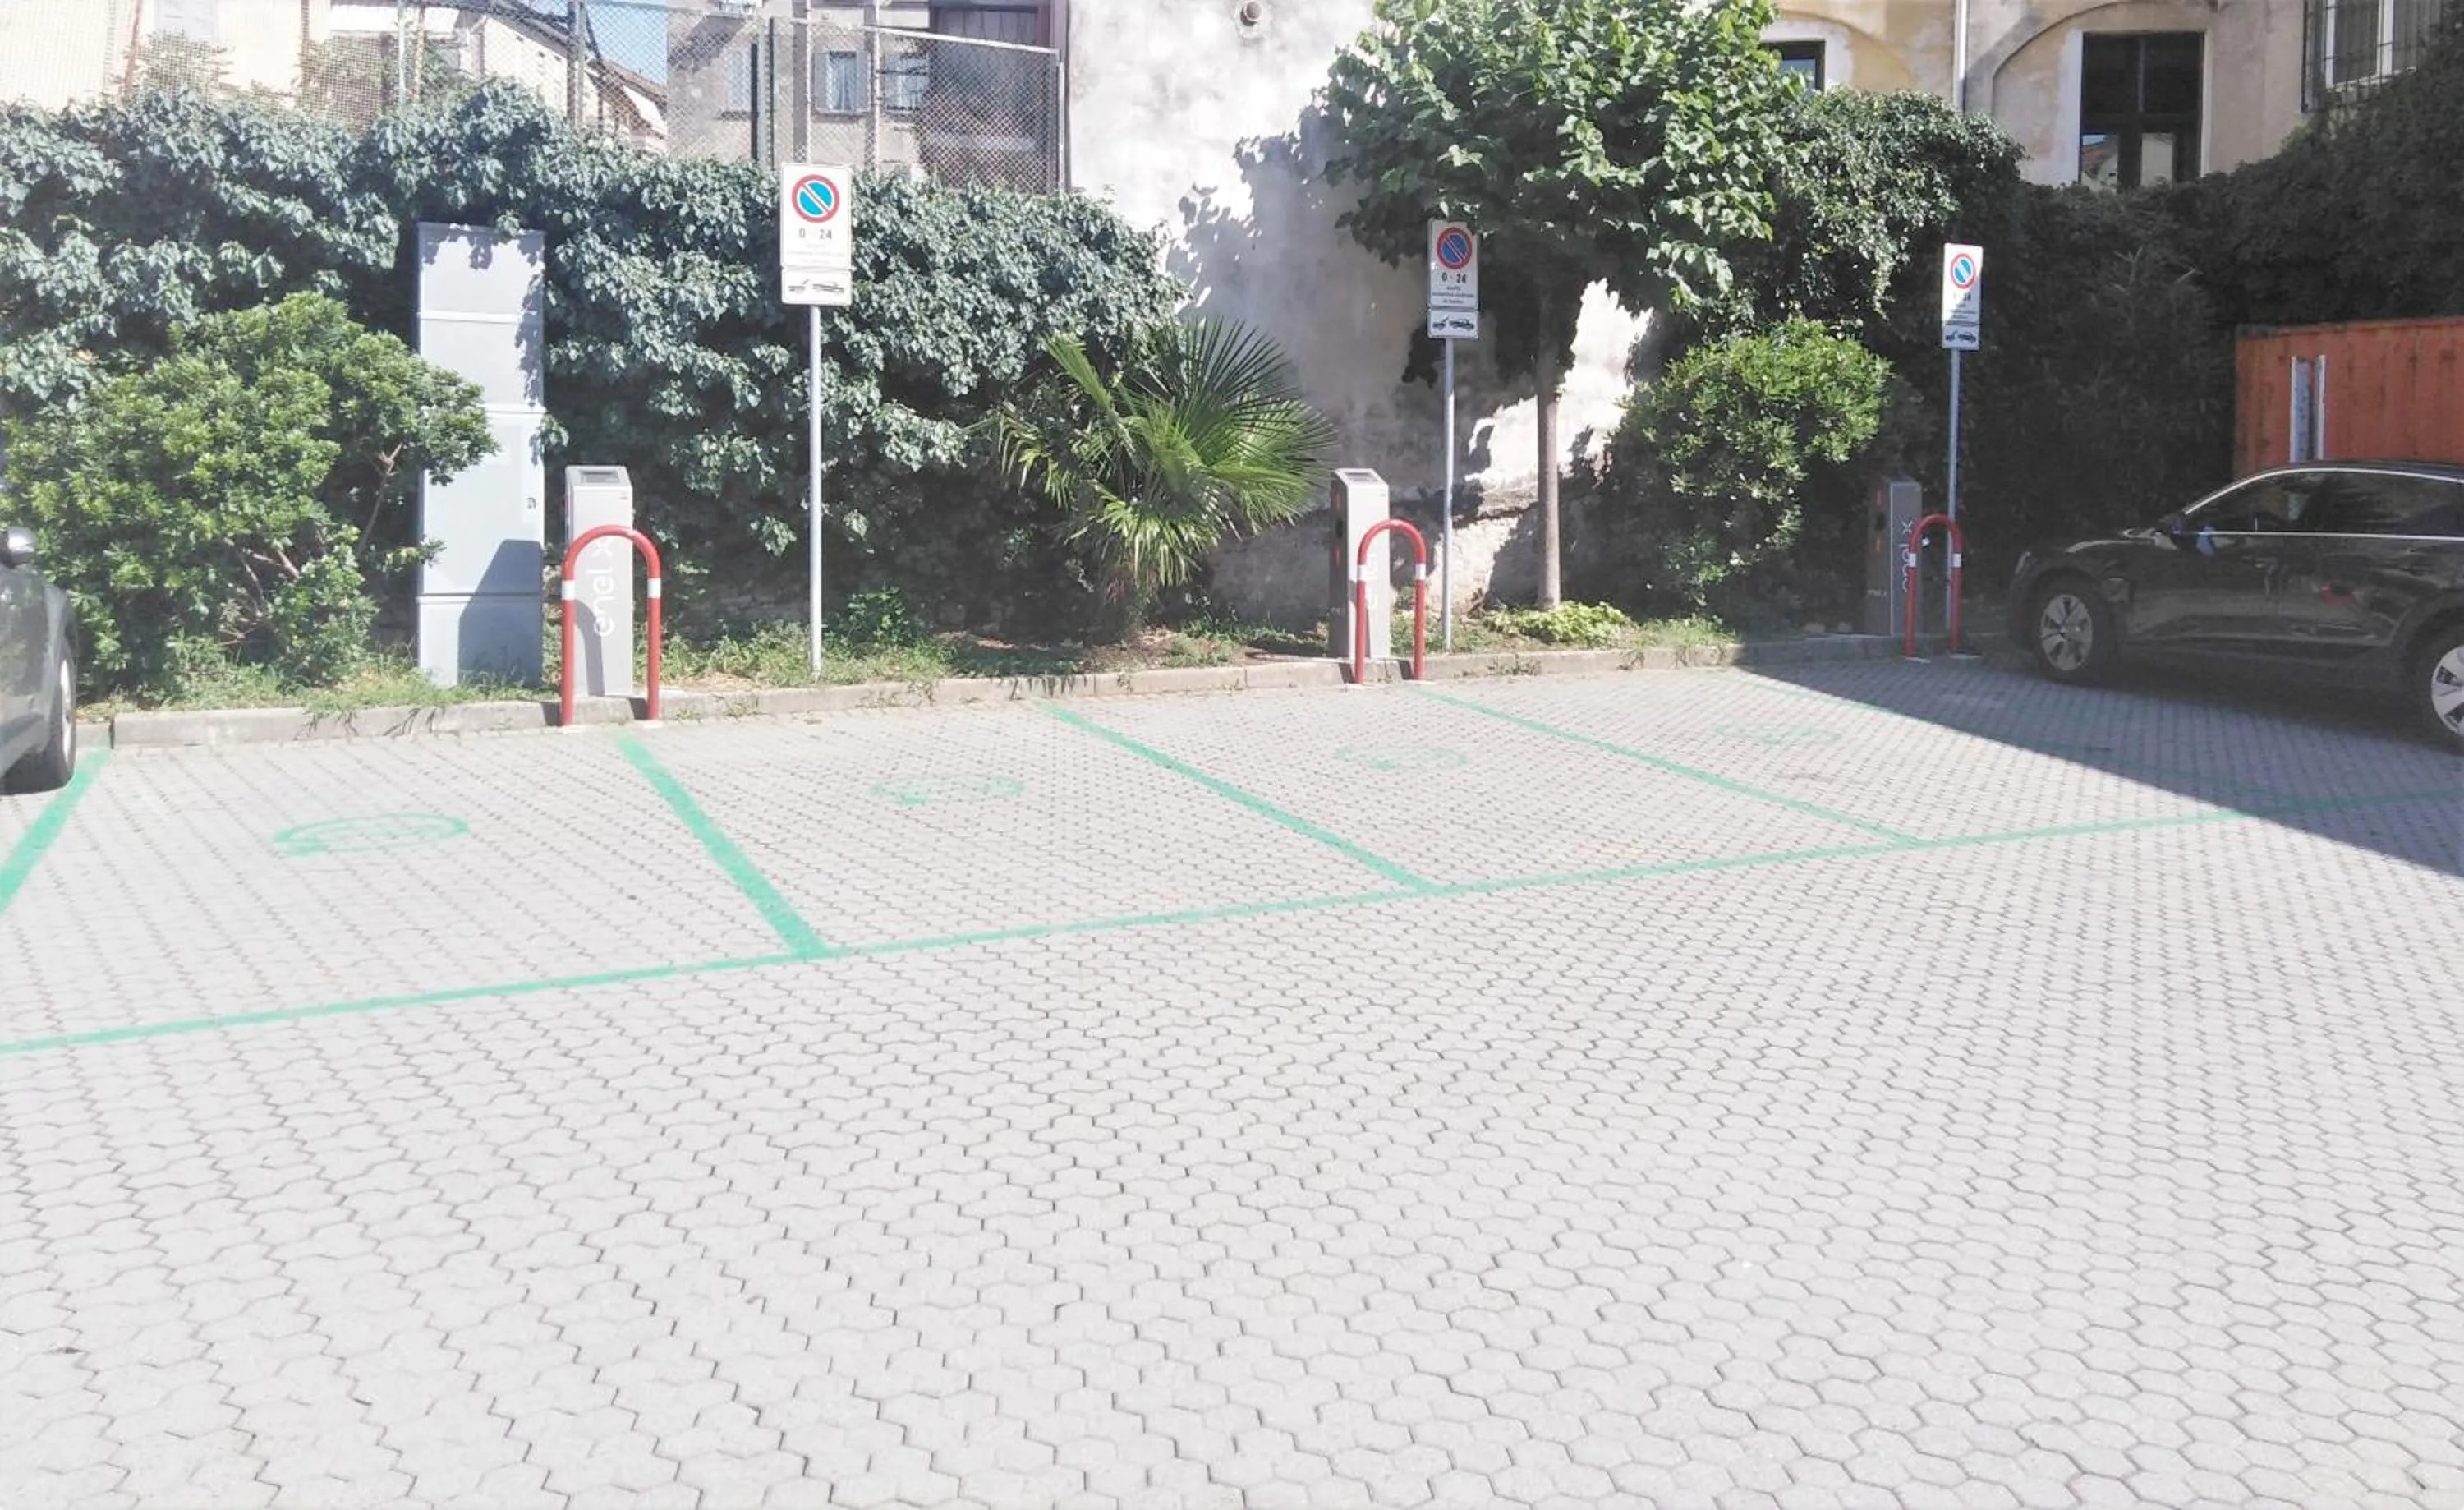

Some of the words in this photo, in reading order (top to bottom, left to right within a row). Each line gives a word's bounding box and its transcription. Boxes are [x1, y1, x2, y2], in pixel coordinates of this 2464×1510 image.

[819, 228, 833, 240] 24
[1456, 273, 1466, 283] 24
[586, 567, 615, 637] enel
